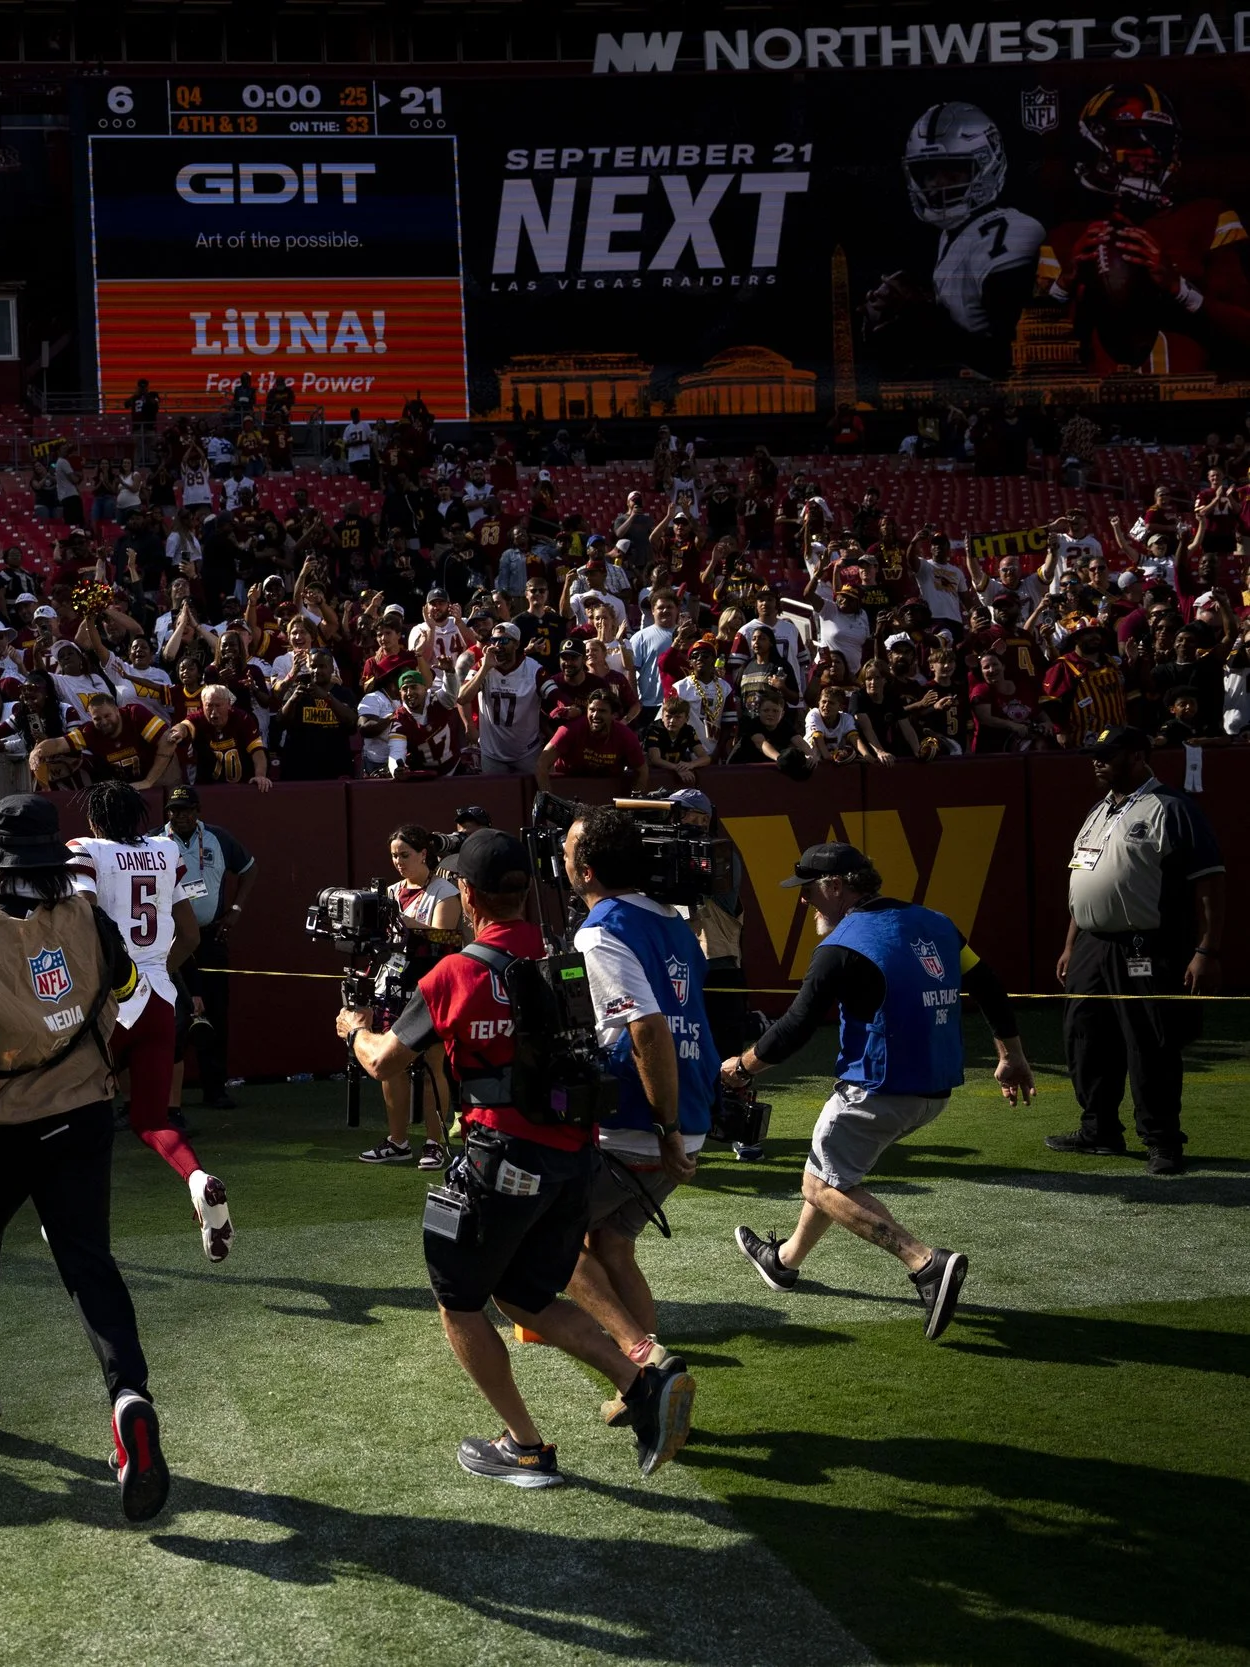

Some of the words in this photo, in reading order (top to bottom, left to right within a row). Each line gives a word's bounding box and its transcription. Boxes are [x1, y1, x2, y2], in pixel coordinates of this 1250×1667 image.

[703, 17, 1097, 70] NORTHWEST
[106, 85, 135, 114] 6
[175, 85, 203, 108] Q4
[241, 84, 322, 108] 0:00
[338, 85, 368, 108] :25
[400, 86, 443, 115] 21
[176, 115, 214, 133] 4TH
[218, 115, 235, 133] &
[238, 114, 259, 133] 13
[289, 120, 307, 133] ON
[308, 120, 340, 133] THE:
[345, 115, 370, 134] 33
[1025, 104, 1055, 125] NFL
[504, 143, 756, 171] SEPTEMBER
[772, 142, 814, 164] 21
[175, 162, 377, 204] GDIT
[491, 171, 811, 275] NEXT
[195, 231, 223, 249] Art
[227, 230, 247, 249] of
[249, 230, 282, 249] the
[285, 231, 364, 252] possible.
[490, 280, 538, 293] LAS
[558, 277, 642, 291] VEGAS
[662, 273, 777, 289] RAIDERS
[189, 307, 388, 355] LiUNA!
[205, 370, 253, 394] Fee
[301, 371, 376, 394] Power
[341, 529, 360, 549] 83
[481, 526, 500, 546] 83
[1018, 647, 1036, 677] 4
[491, 692, 516, 727] 17
[945, 710, 958, 737] 5
[417, 723, 453, 767] 17
[116, 852, 167, 871] DANIELS
[130, 875, 158, 947] 5
[921, 955, 944, 976] NFL
[37, 967, 68, 996] NFL
[922, 990, 940, 1008] NFL
[518, 1455, 541, 1467] HOKA
